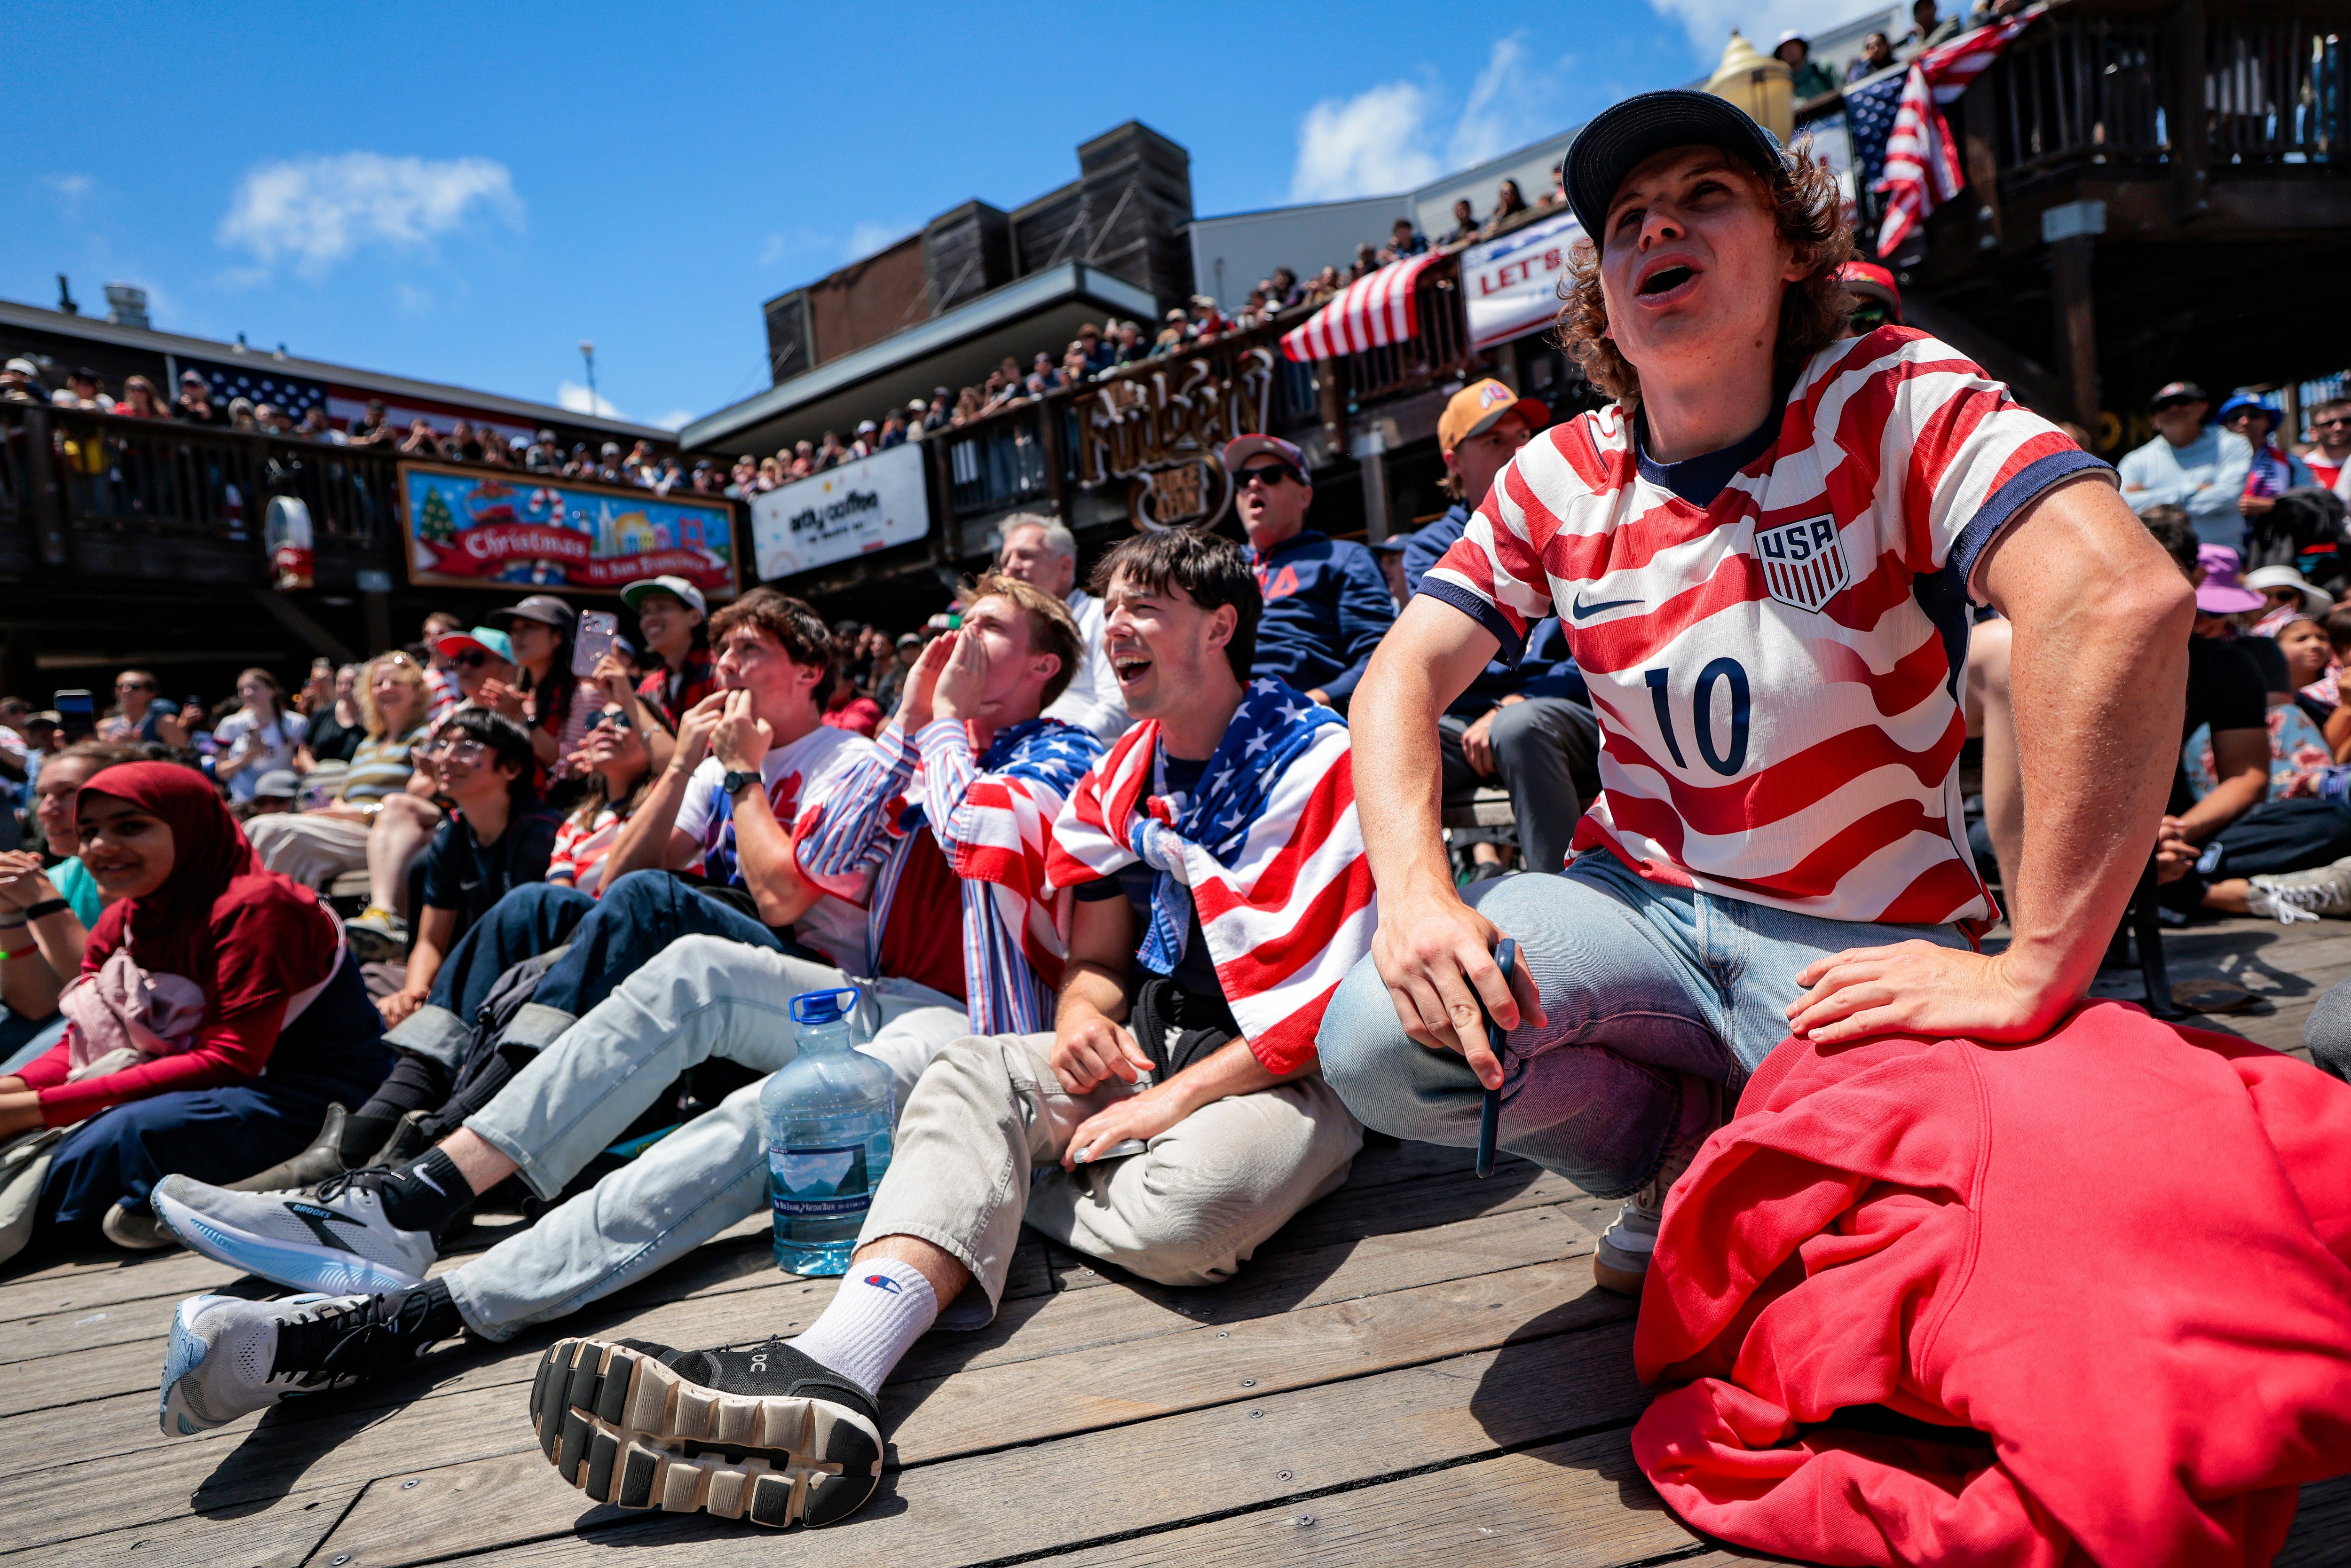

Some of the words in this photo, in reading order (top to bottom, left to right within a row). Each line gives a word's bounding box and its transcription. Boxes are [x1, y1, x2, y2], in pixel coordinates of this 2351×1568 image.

[1482, 249, 1562, 295] LET'S
[465, 528, 586, 559] Christmas
[1761, 519, 1833, 560] USA
[1645, 657, 1750, 776] 10
[293, 1204, 332, 1219] BROOKS
